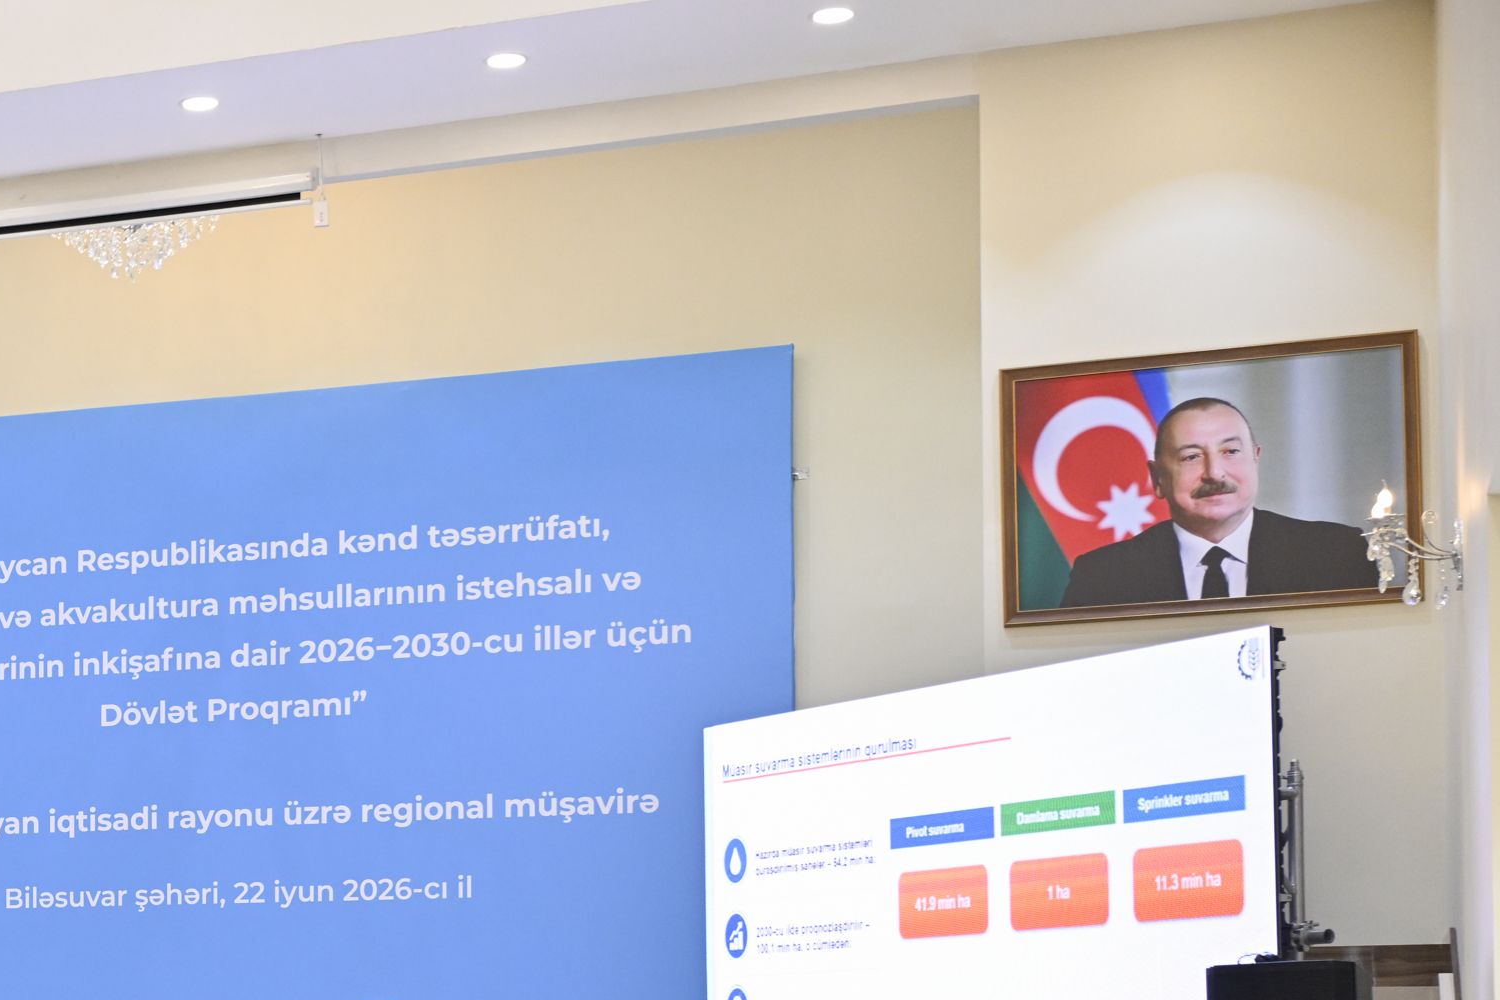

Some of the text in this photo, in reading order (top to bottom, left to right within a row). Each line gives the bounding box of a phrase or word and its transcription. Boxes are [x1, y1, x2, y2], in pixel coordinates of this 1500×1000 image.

[77, 532, 328, 575] Respublikasında
[338, 524, 418, 555] kənd
[427, 514, 610, 549] təsərrüfatı,
[40, 595, 219, 627] akvakultura
[229, 582, 446, 615] məhsullarının
[456, 568, 592, 601] istehsalı
[601, 571, 642, 592] və
[73, 646, 221, 680] inkişafına
[230, 639, 291, 668] dair
[299, 631, 523, 664] 2026–2030-cu
[533, 624, 597, 652] illər
[606, 618, 692, 654] üçün
[100, 689, 368, 727] Dövlət Proqramı”
[755, 756, 795, 773] suvarma
[48, 804, 158, 839] iqtisadi
[168, 807, 273, 835] rayonu
[283, 800, 352, 826] üzrə
[361, 792, 494, 828] regional
[504, 786, 660, 824] müşavirə
[1137, 790, 1229, 813] Sprinkler suvarma
[1016, 805, 1100, 825] Damlama suvarma
[906, 822, 964, 839] Pivot suvarma
[1047, 885, 1071, 900] 1 ha
[1155, 871, 1222, 891] 11.3 min ha
[5, 874, 472, 913] Biləsuvar şəhəri, 22 iyun 2026-cı il
[915, 894, 971, 911] 41.9 min ha
